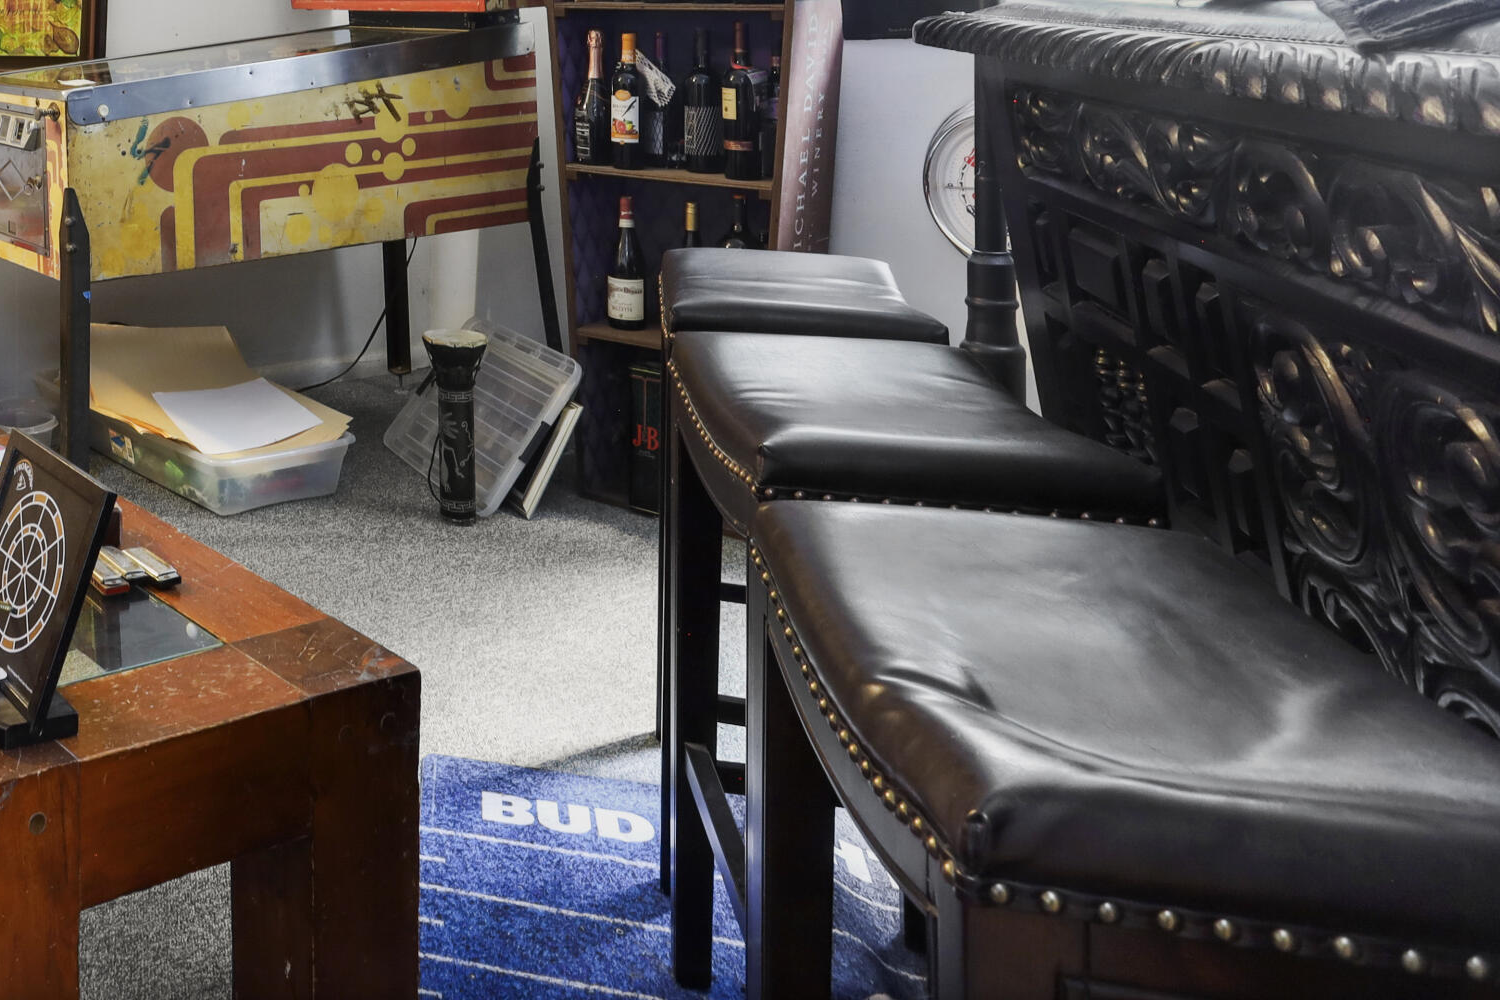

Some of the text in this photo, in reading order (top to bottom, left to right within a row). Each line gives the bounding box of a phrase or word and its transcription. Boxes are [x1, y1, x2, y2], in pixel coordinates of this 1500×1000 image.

[793, 15, 819, 248] ICHAEL DAVID
[812, 93, 825, 197] WINERY
[481, 792, 655, 843] BUD
